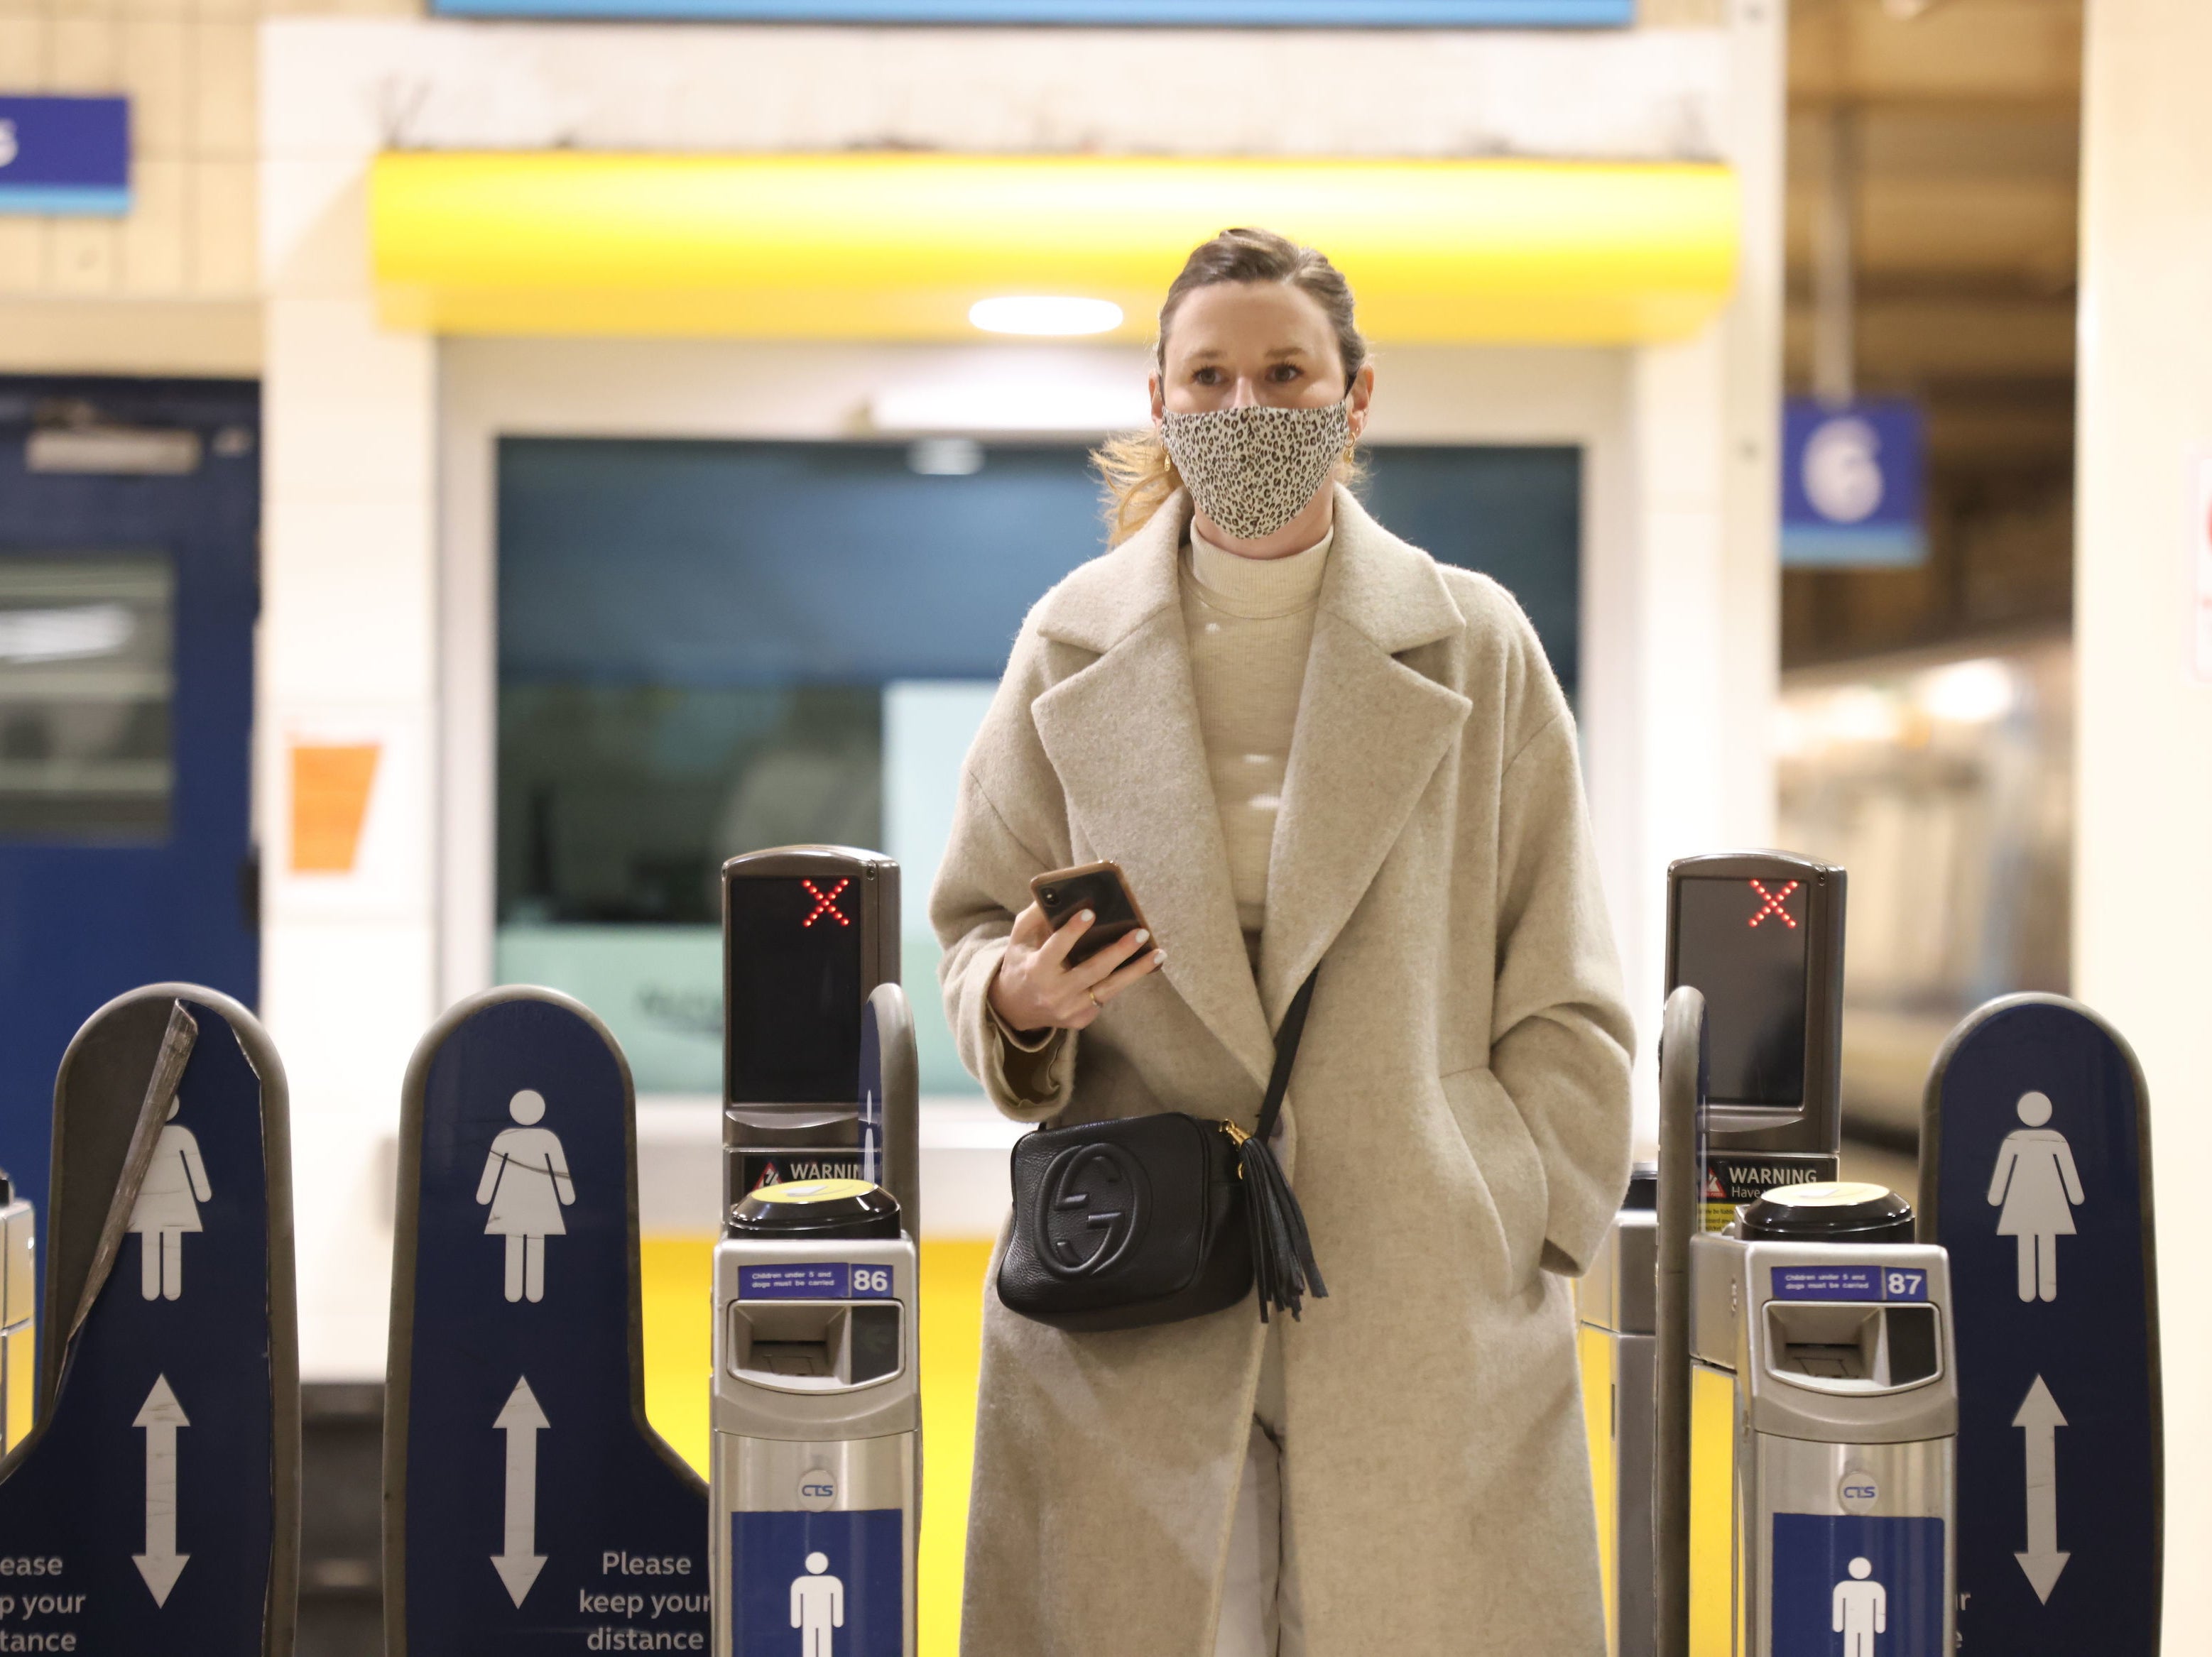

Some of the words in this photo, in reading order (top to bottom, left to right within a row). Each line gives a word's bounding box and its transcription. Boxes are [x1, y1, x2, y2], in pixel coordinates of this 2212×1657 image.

[1728, 1167, 1817, 1184] WARNING
[1731, 1186, 1760, 1198] Have
[854, 1269, 888, 1291] 86
[1887, 1273, 1922, 1295] 87
[802, 1484, 833, 1497] CTS
[1843, 1487, 1875, 1499] CTS
[0, 1558, 63, 1575] ease
[604, 1551, 692, 1575] Please
[22, 1595, 86, 1620] your
[579, 1589, 643, 1619] keep
[651, 1595, 709, 1619] your
[0, 1629, 76, 1651] tance
[587, 1627, 704, 1651] distance
